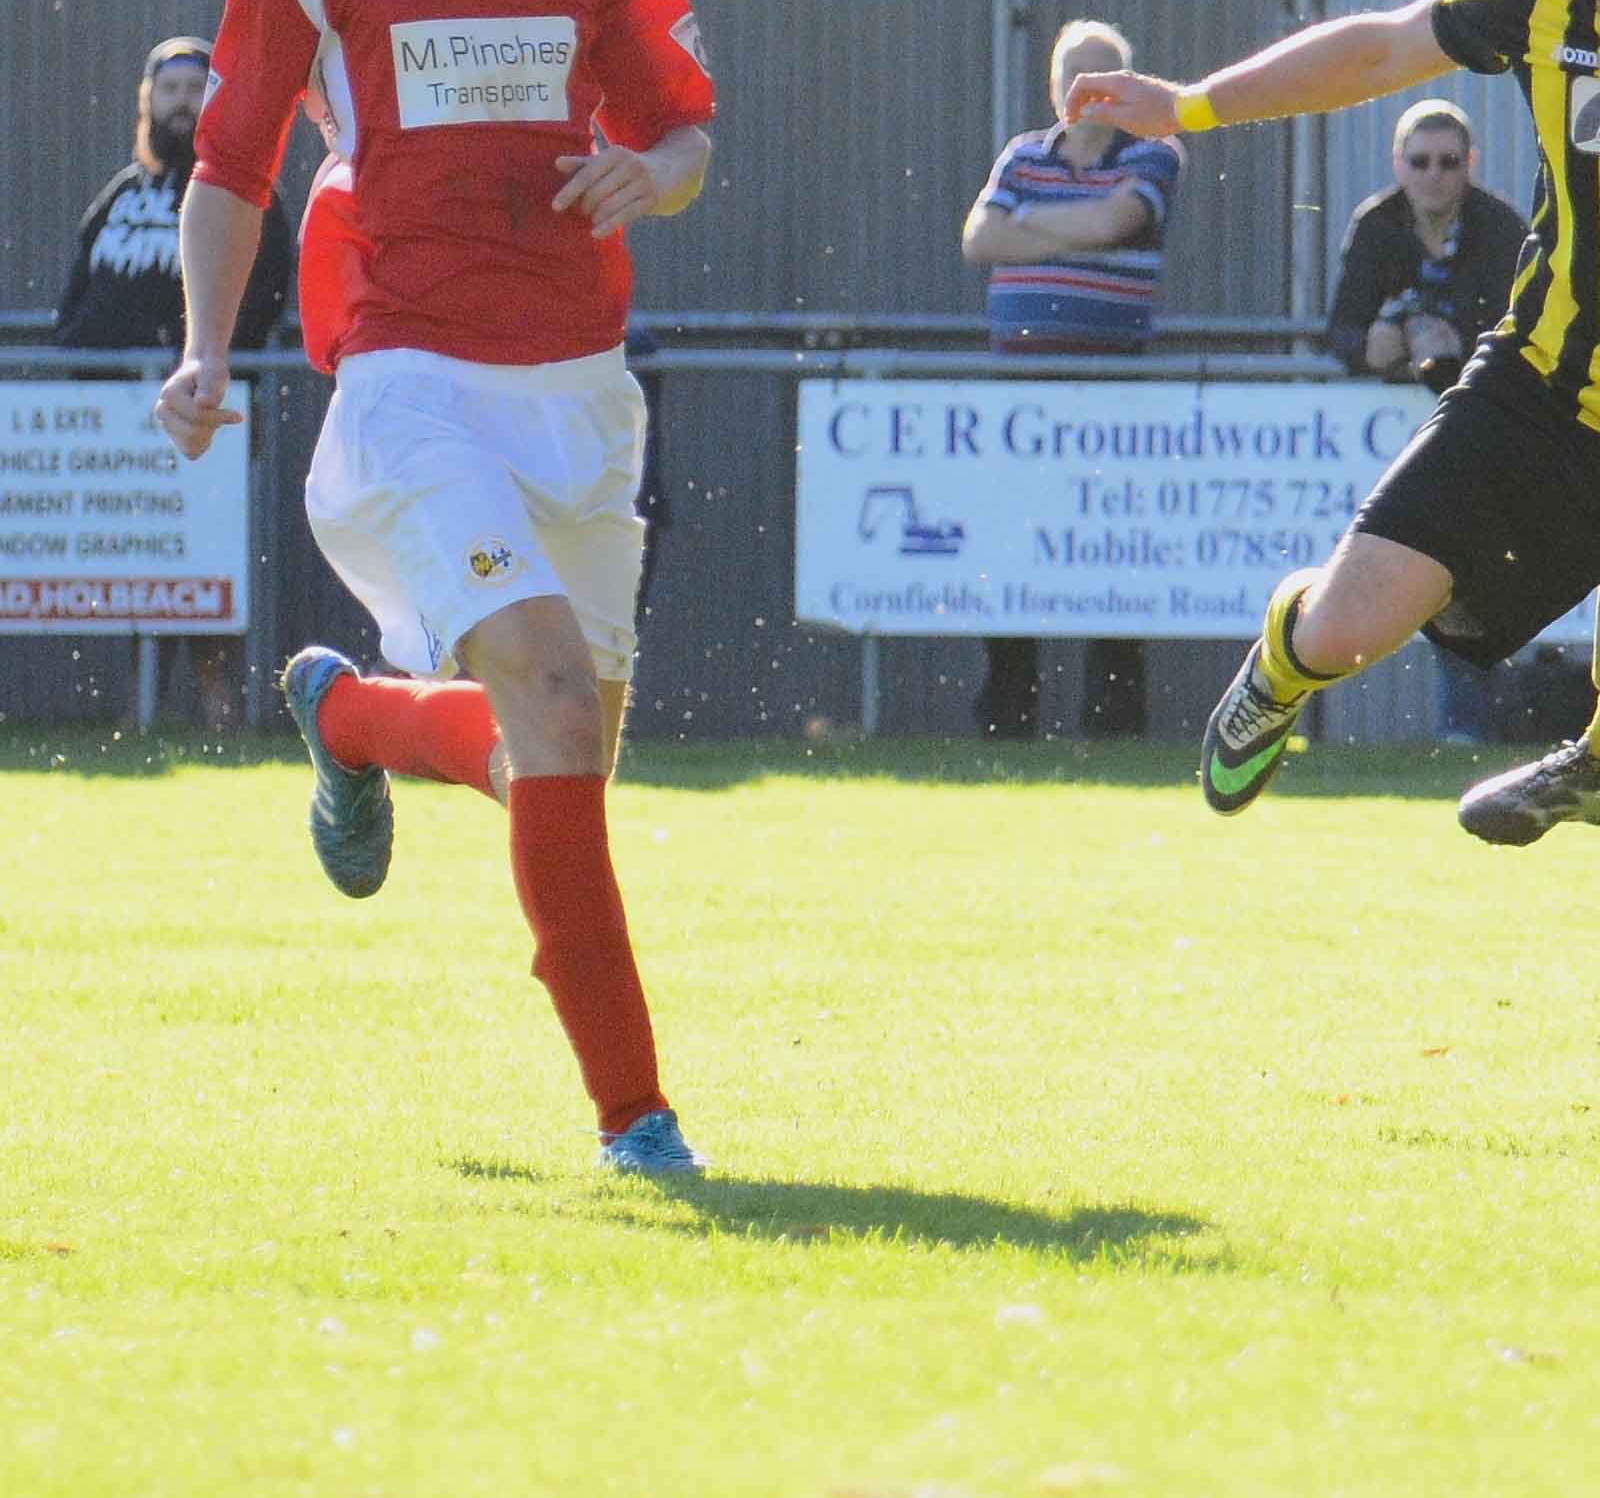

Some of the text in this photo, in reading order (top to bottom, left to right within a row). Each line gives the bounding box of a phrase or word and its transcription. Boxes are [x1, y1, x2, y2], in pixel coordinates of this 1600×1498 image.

[402, 34, 569, 73] M.Pinches
[427, 80, 549, 108] Transport
[1001, 405, 1341, 460] Groundwork
[68, 448, 178, 476] GRAPHICS
[82, 489, 184, 516] PRINTING
[1076, 477, 1144, 519] Tel:
[1156, 478, 1277, 519] 01775
[75, 531, 186, 560] GRAPHICS
[1033, 527, 1185, 569] Mobile:
[1195, 529, 1315, 569] 07850
[1002, 581, 1158, 616] Horseshoe
